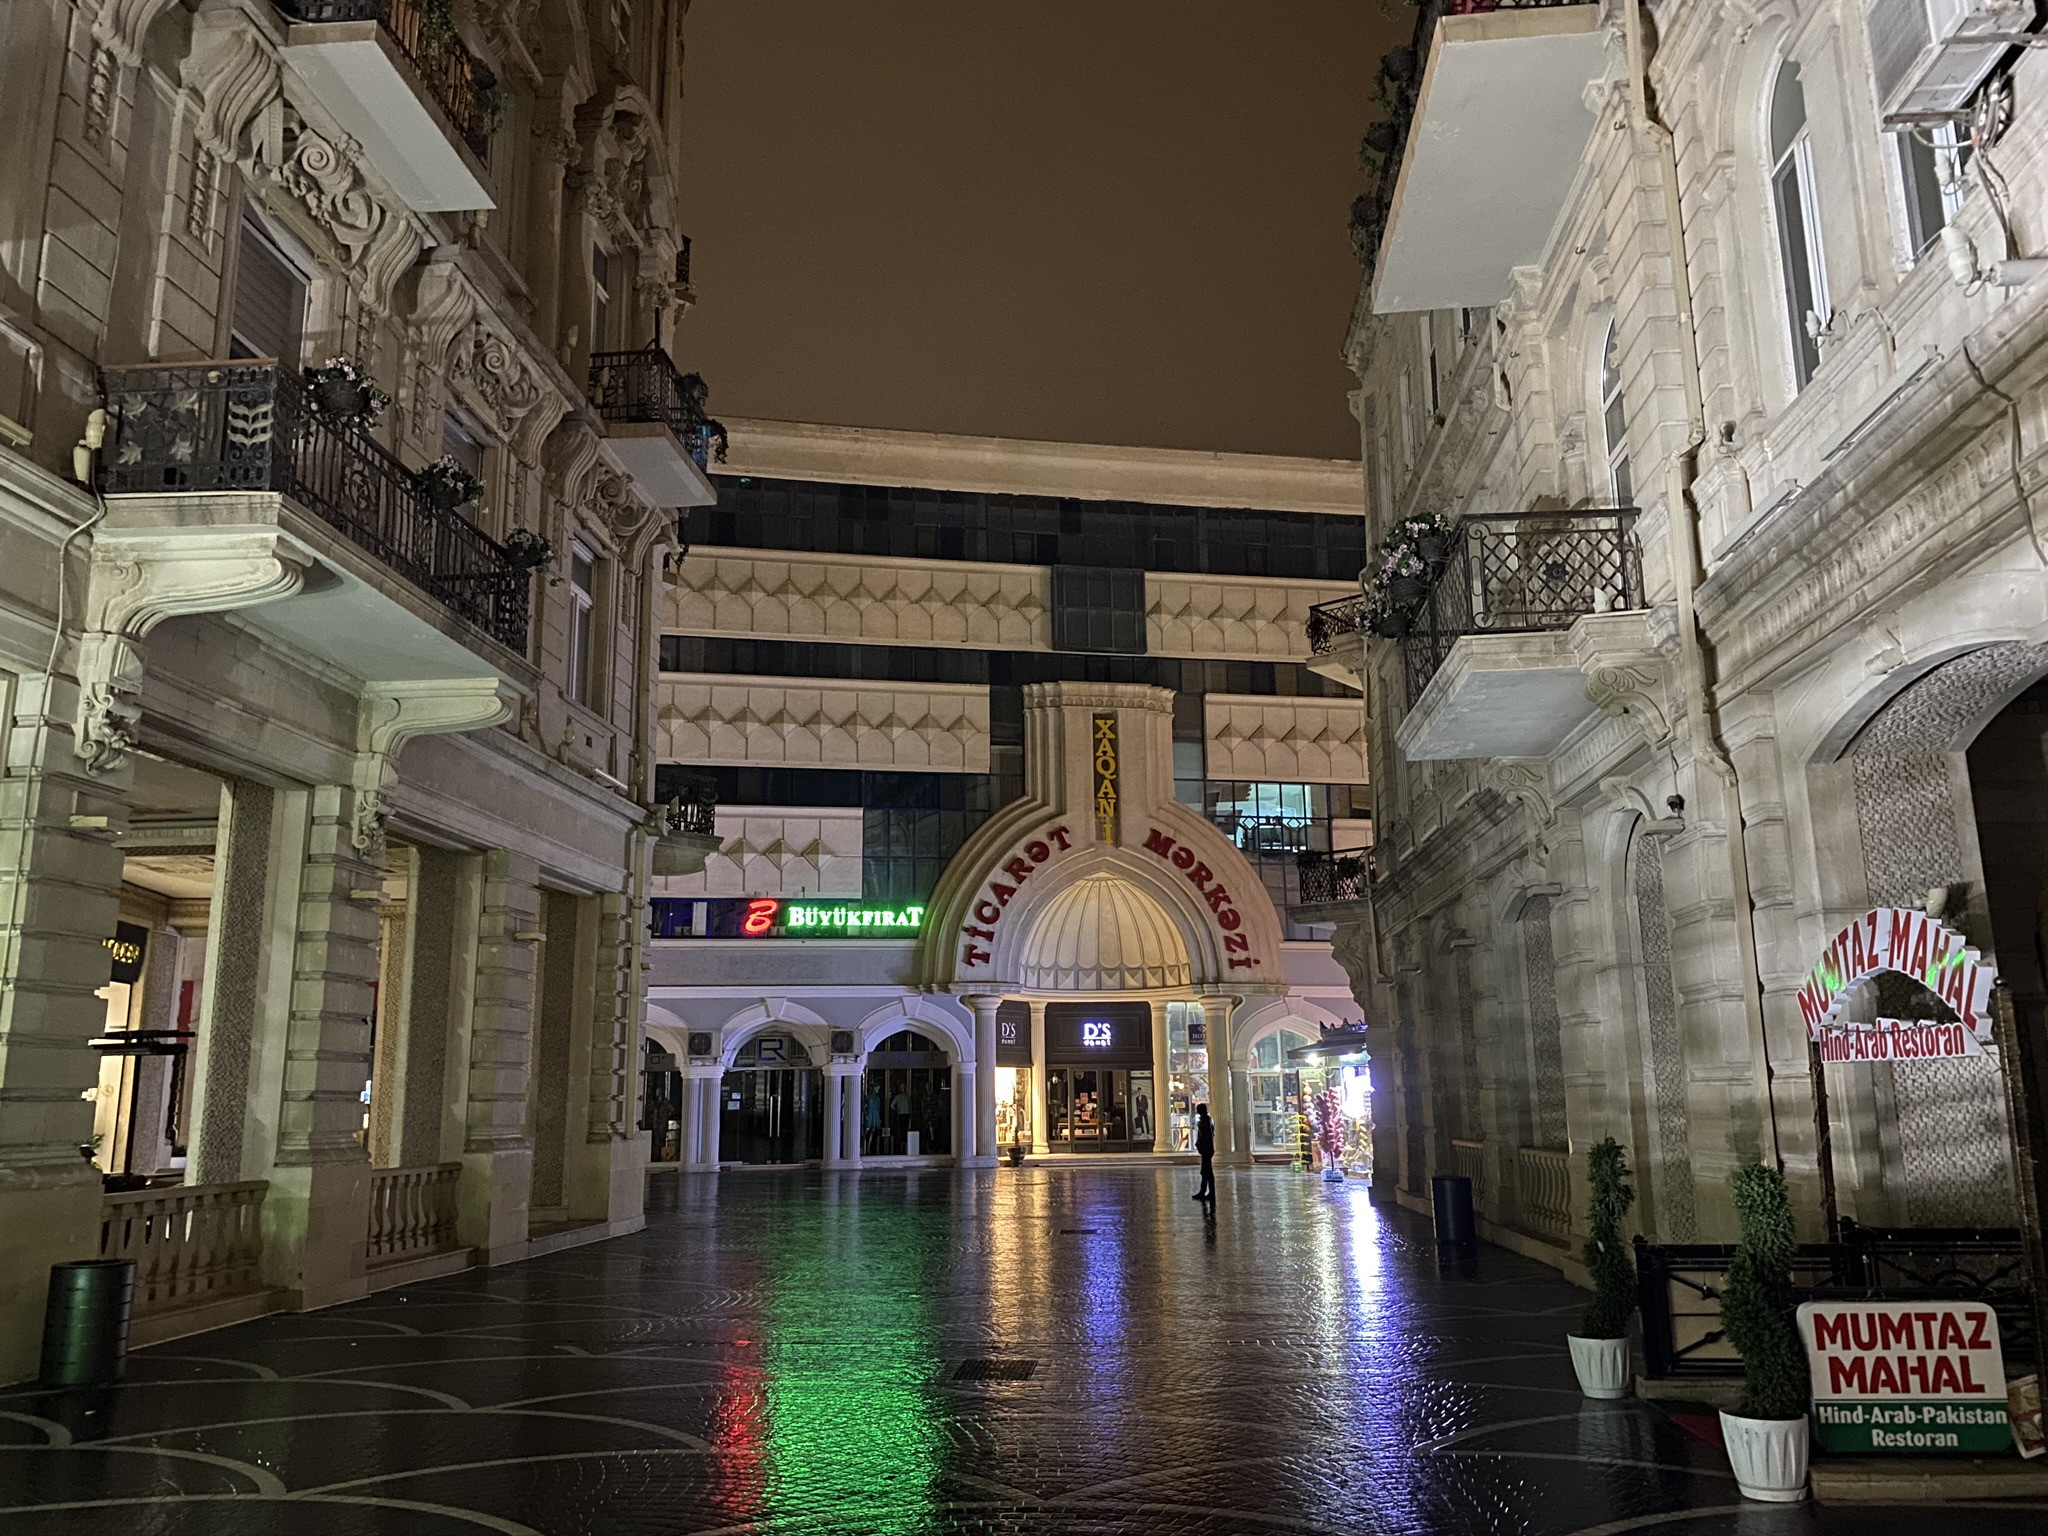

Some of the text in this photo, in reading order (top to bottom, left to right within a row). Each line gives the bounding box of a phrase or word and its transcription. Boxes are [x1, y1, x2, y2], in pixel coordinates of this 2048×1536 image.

[961, 826, 1072, 967] TİCARƏT
[1142, 828, 1260, 970] MƏRKƏZİ
[1796, 908, 1978, 1039] MUMTAZ MAHAL
[1819, 1019, 1966, 1062] Hind-Arab Restoran
[1813, 1312, 1992, 1351] MUMTAZ
[1828, 1355, 1986, 1394] MAHAL
[1819, 1406, 2008, 1425] Hind-Arab-Pakistan
[1872, 1429, 1959, 1447] Restoran
